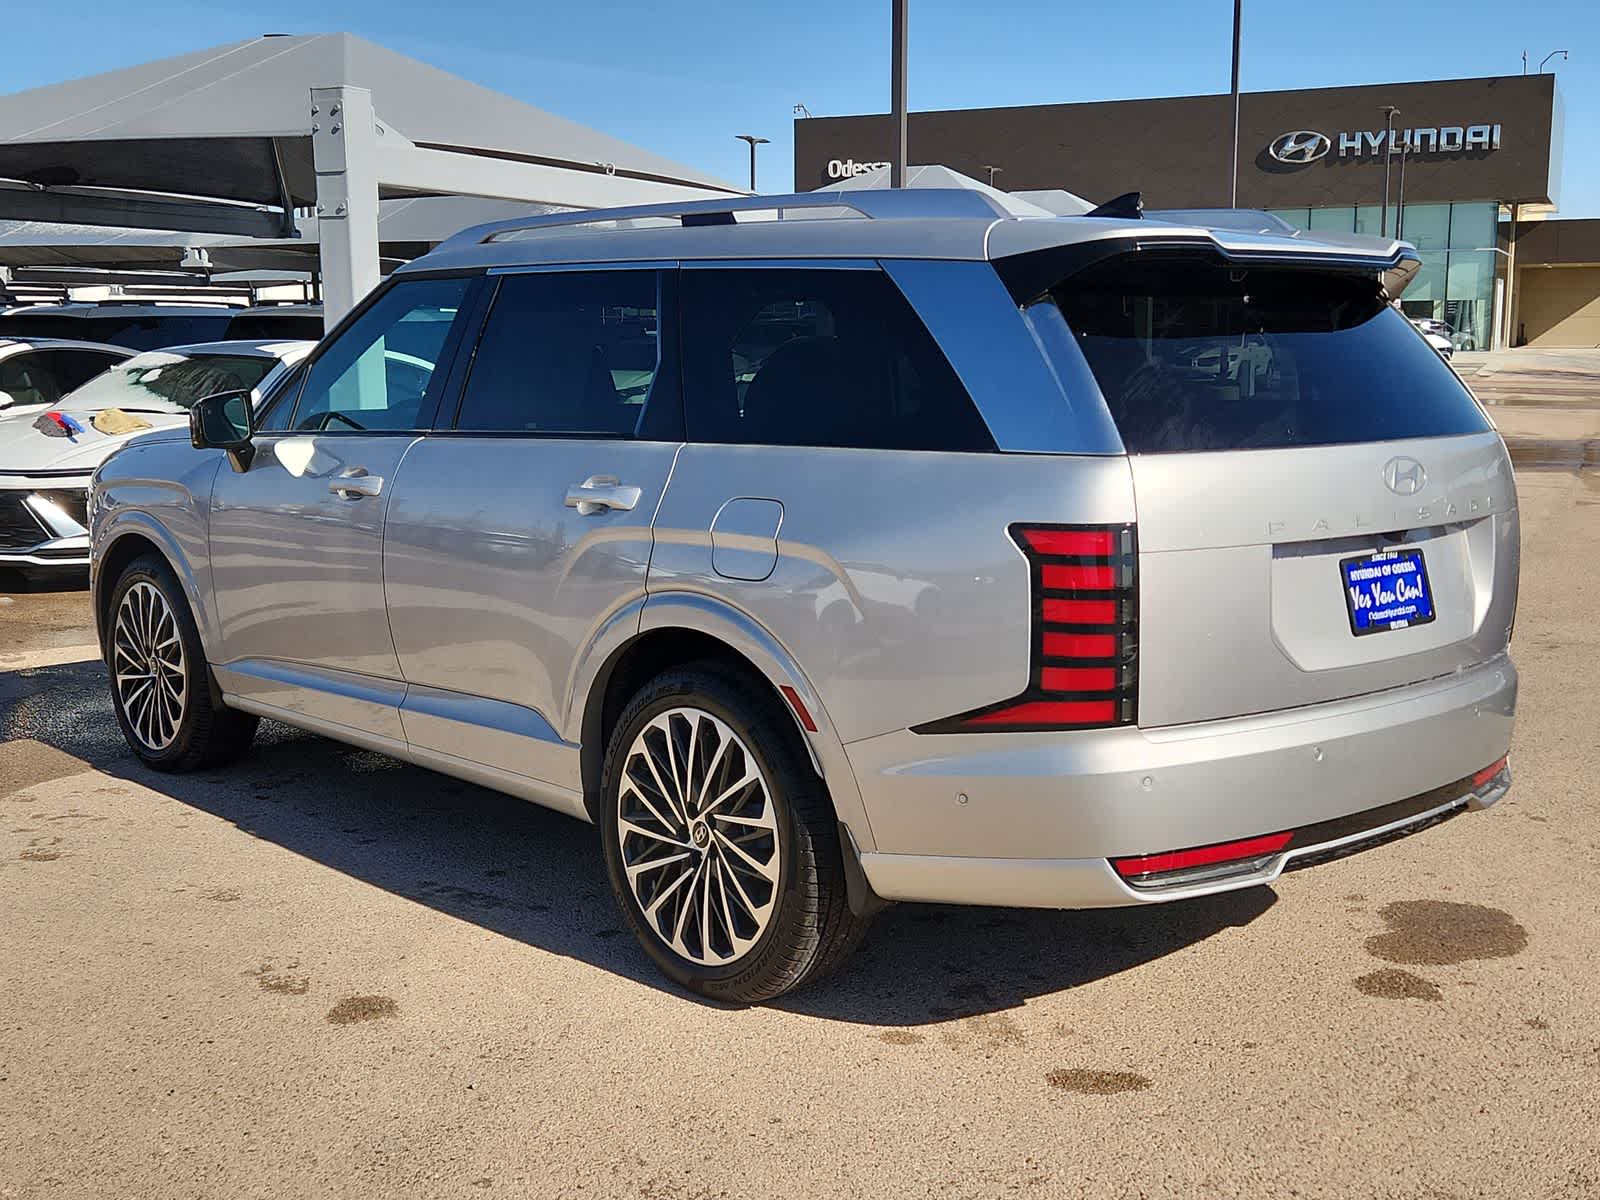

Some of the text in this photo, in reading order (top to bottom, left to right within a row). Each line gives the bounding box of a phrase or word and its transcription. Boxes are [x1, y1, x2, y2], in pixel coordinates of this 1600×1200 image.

[1338, 124, 1502, 157] HYUNDAI
[1349, 585, 1372, 611] Yes
[1371, 581, 1396, 607] You
